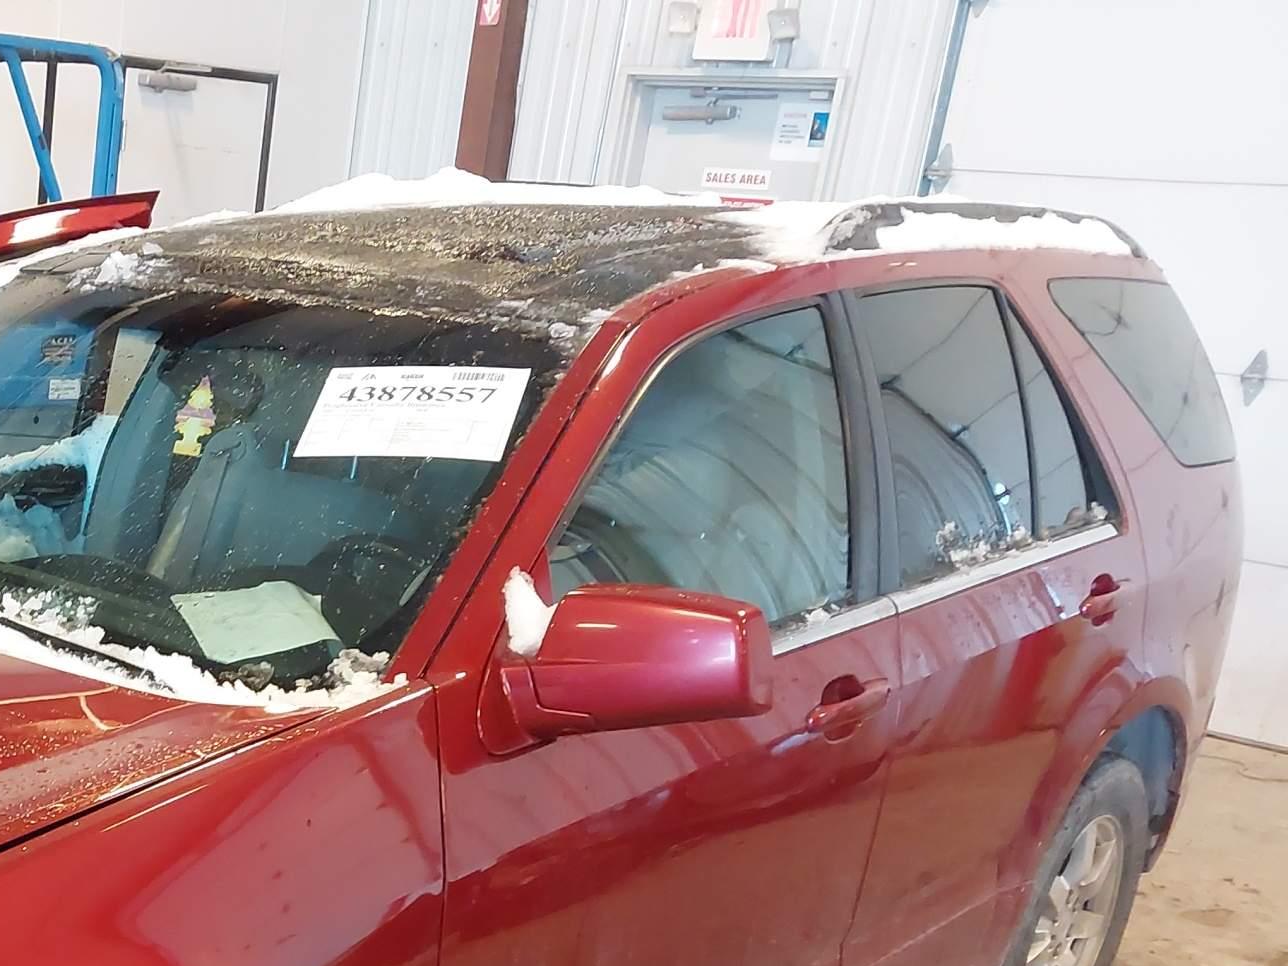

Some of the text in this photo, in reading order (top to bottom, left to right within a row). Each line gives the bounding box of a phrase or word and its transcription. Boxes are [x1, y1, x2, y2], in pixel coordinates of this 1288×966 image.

[705, 172, 767, 185] SALES AREA
[338, 385, 498, 404] 43878557
